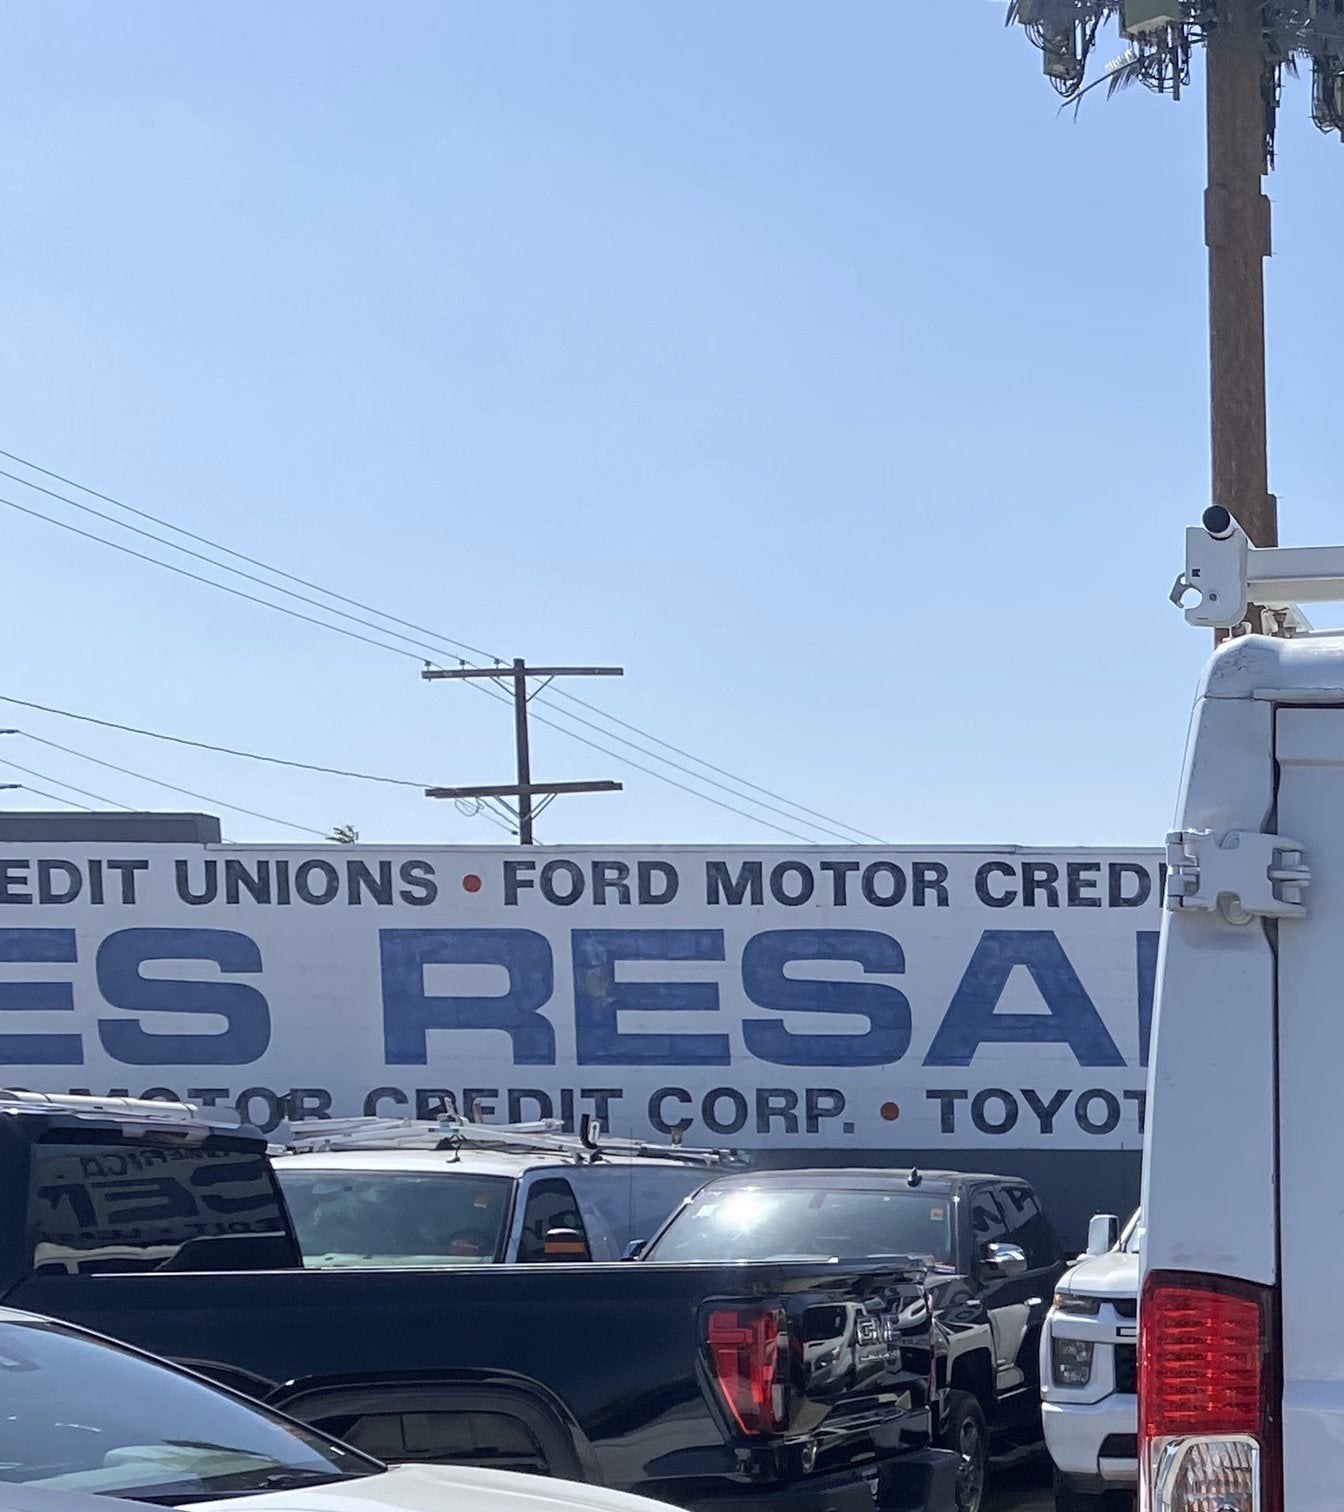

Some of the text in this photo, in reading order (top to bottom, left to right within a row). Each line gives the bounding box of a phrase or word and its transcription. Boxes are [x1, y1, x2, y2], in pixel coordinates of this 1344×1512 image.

[0, 859, 149, 905] EDIT
[175, 859, 437, 907] UNIONS
[504, 860, 679, 907] FORD
[705, 861, 949, 907] MOTOR
[647, 1086, 856, 1135] CORP.
